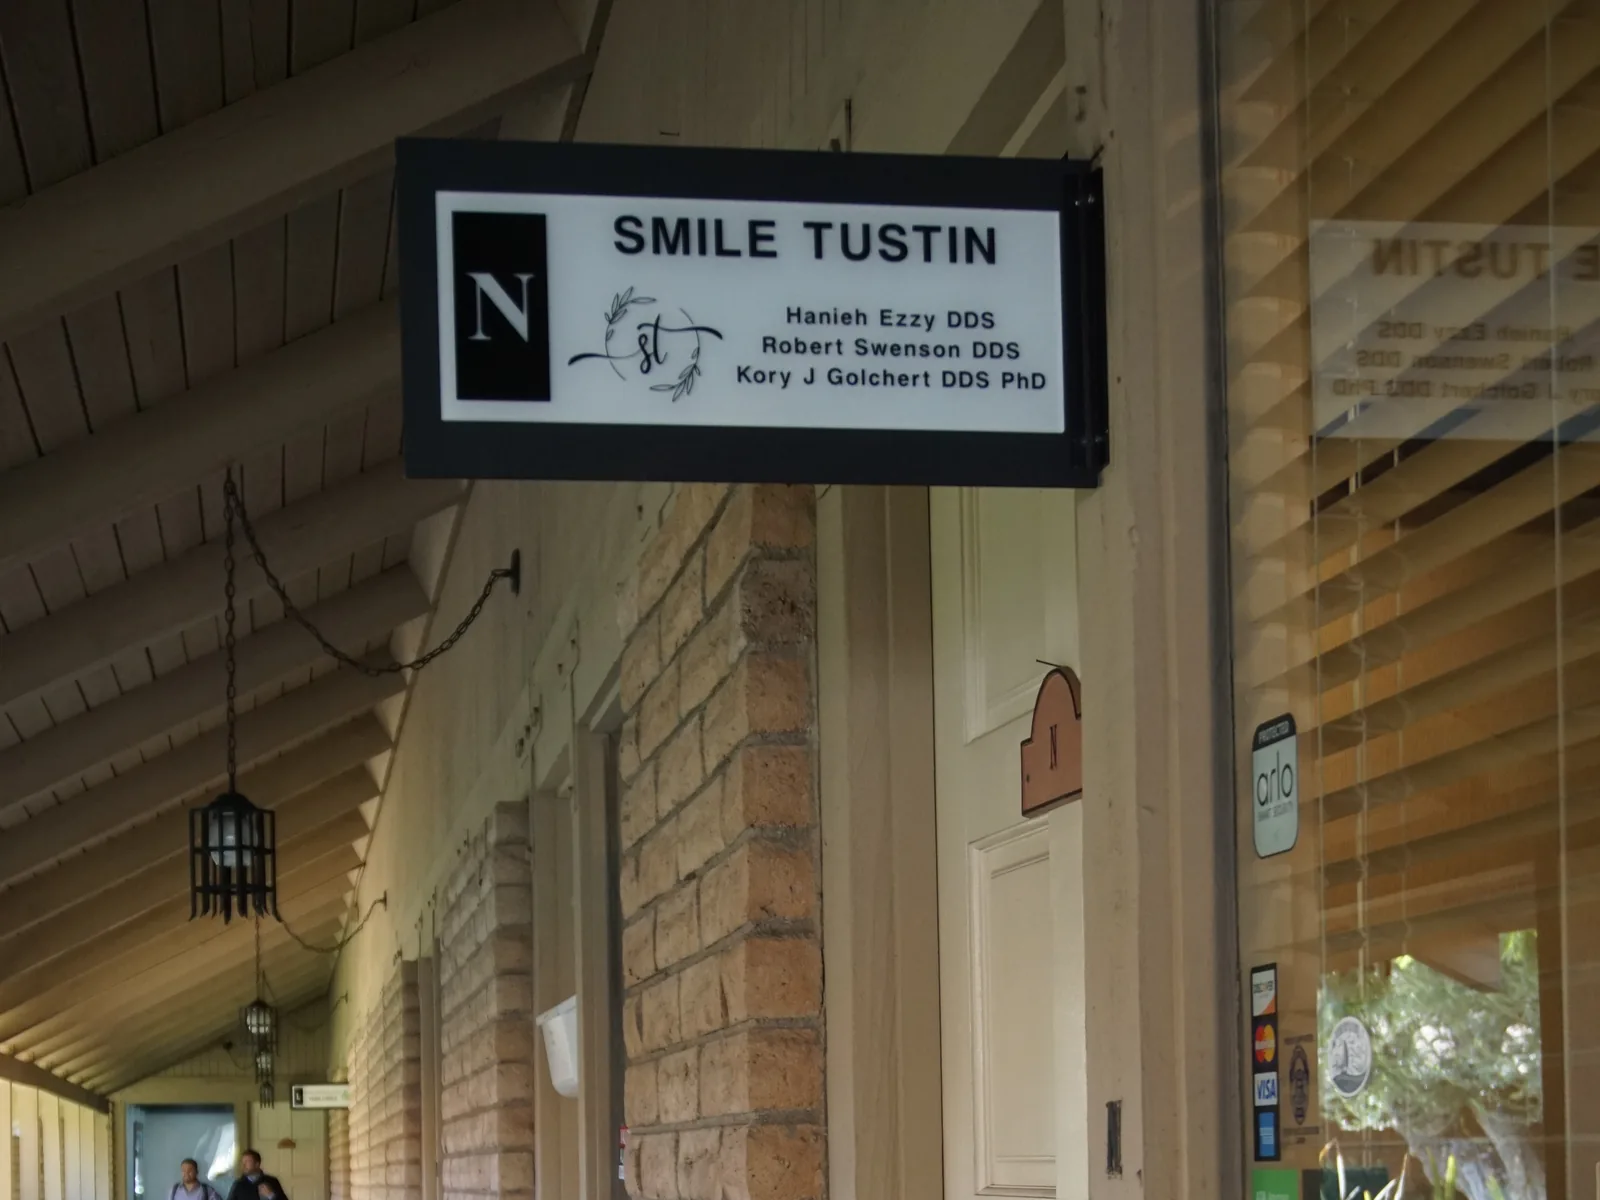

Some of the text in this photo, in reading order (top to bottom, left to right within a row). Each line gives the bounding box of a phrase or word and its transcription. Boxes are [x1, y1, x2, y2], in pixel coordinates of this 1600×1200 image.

[614, 215, 996, 265] SMILE TUSTIN
[465, 271, 535, 343] N
[786, 306, 996, 332] Hanieh Ezzy DDS
[761, 336, 1021, 360] Robert Swenson DDS
[736, 365, 1047, 390] Kory J Golchert DDS PhD
[1256, 750, 1293, 806] arlo
[1257, 1078, 1276, 1099] VISA
